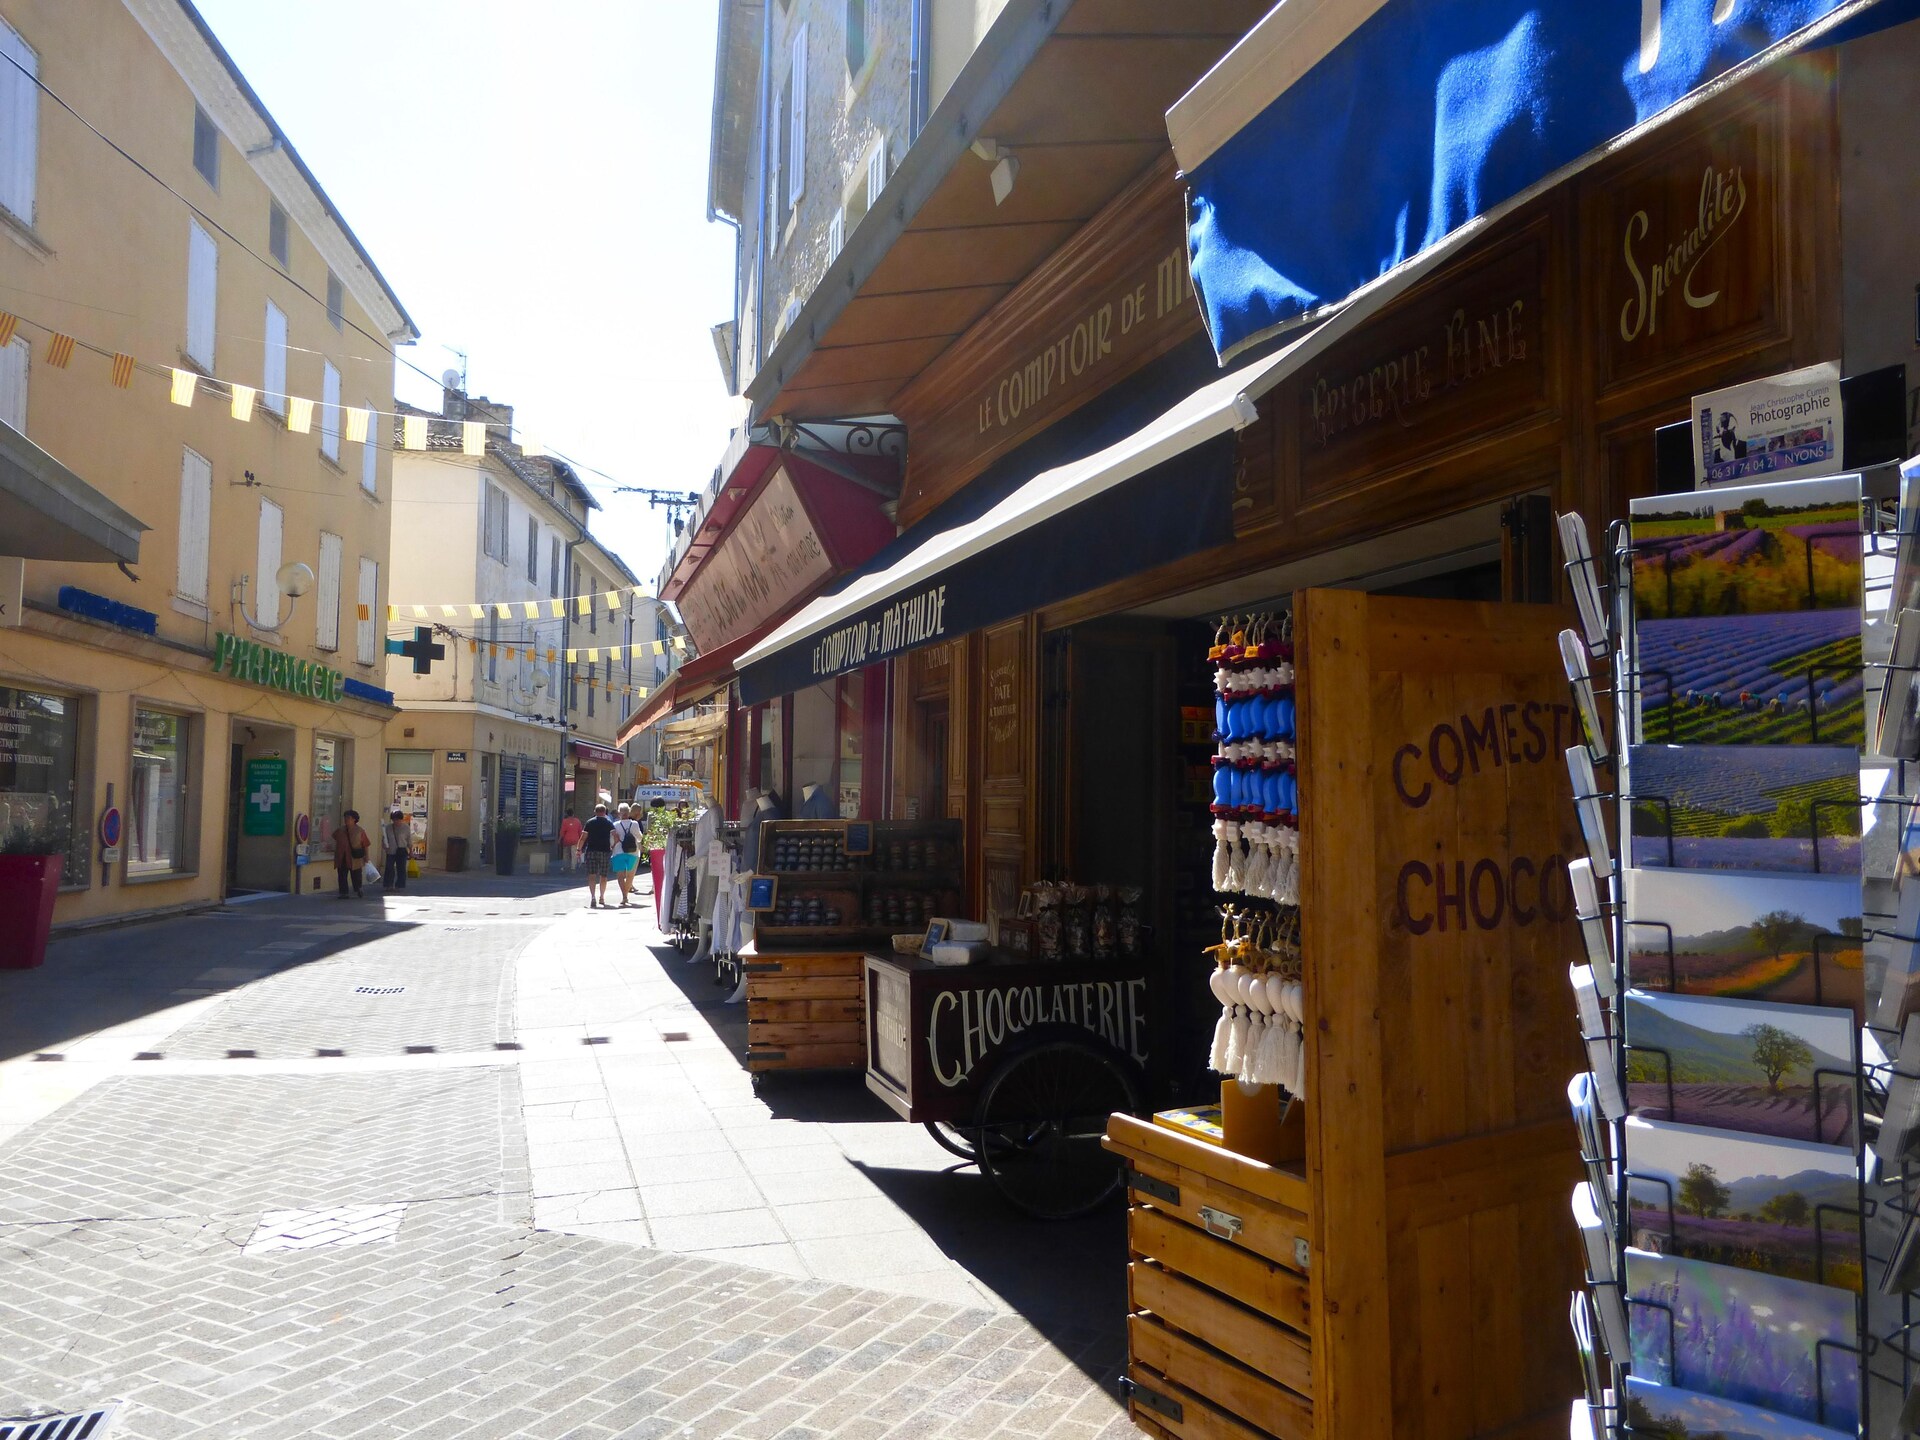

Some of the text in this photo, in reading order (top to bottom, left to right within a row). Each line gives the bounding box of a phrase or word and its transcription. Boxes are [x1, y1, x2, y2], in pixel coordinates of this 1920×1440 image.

[1620, 165, 1747, 342] Spécialités
[979, 396, 992, 434] LE
[998, 302, 1113, 427] COMPTOIR
[1121, 283, 1146, 335] DE
[1445, 300, 1527, 390] FINE
[1749, 402, 1766, 413] Jean
[1767, 392, 1805, 408] Christophe
[1750, 396, 1831, 426] Photographie
[1712, 446, 1824, 479] 06 31 74 04 21 NYONS
[212, 630, 344, 704] PHARMACIE
[813, 584, 946, 675] LE COMPTOIR DE MATHILDE
[926, 977, 1149, 1087] CHOCOLATERIE
